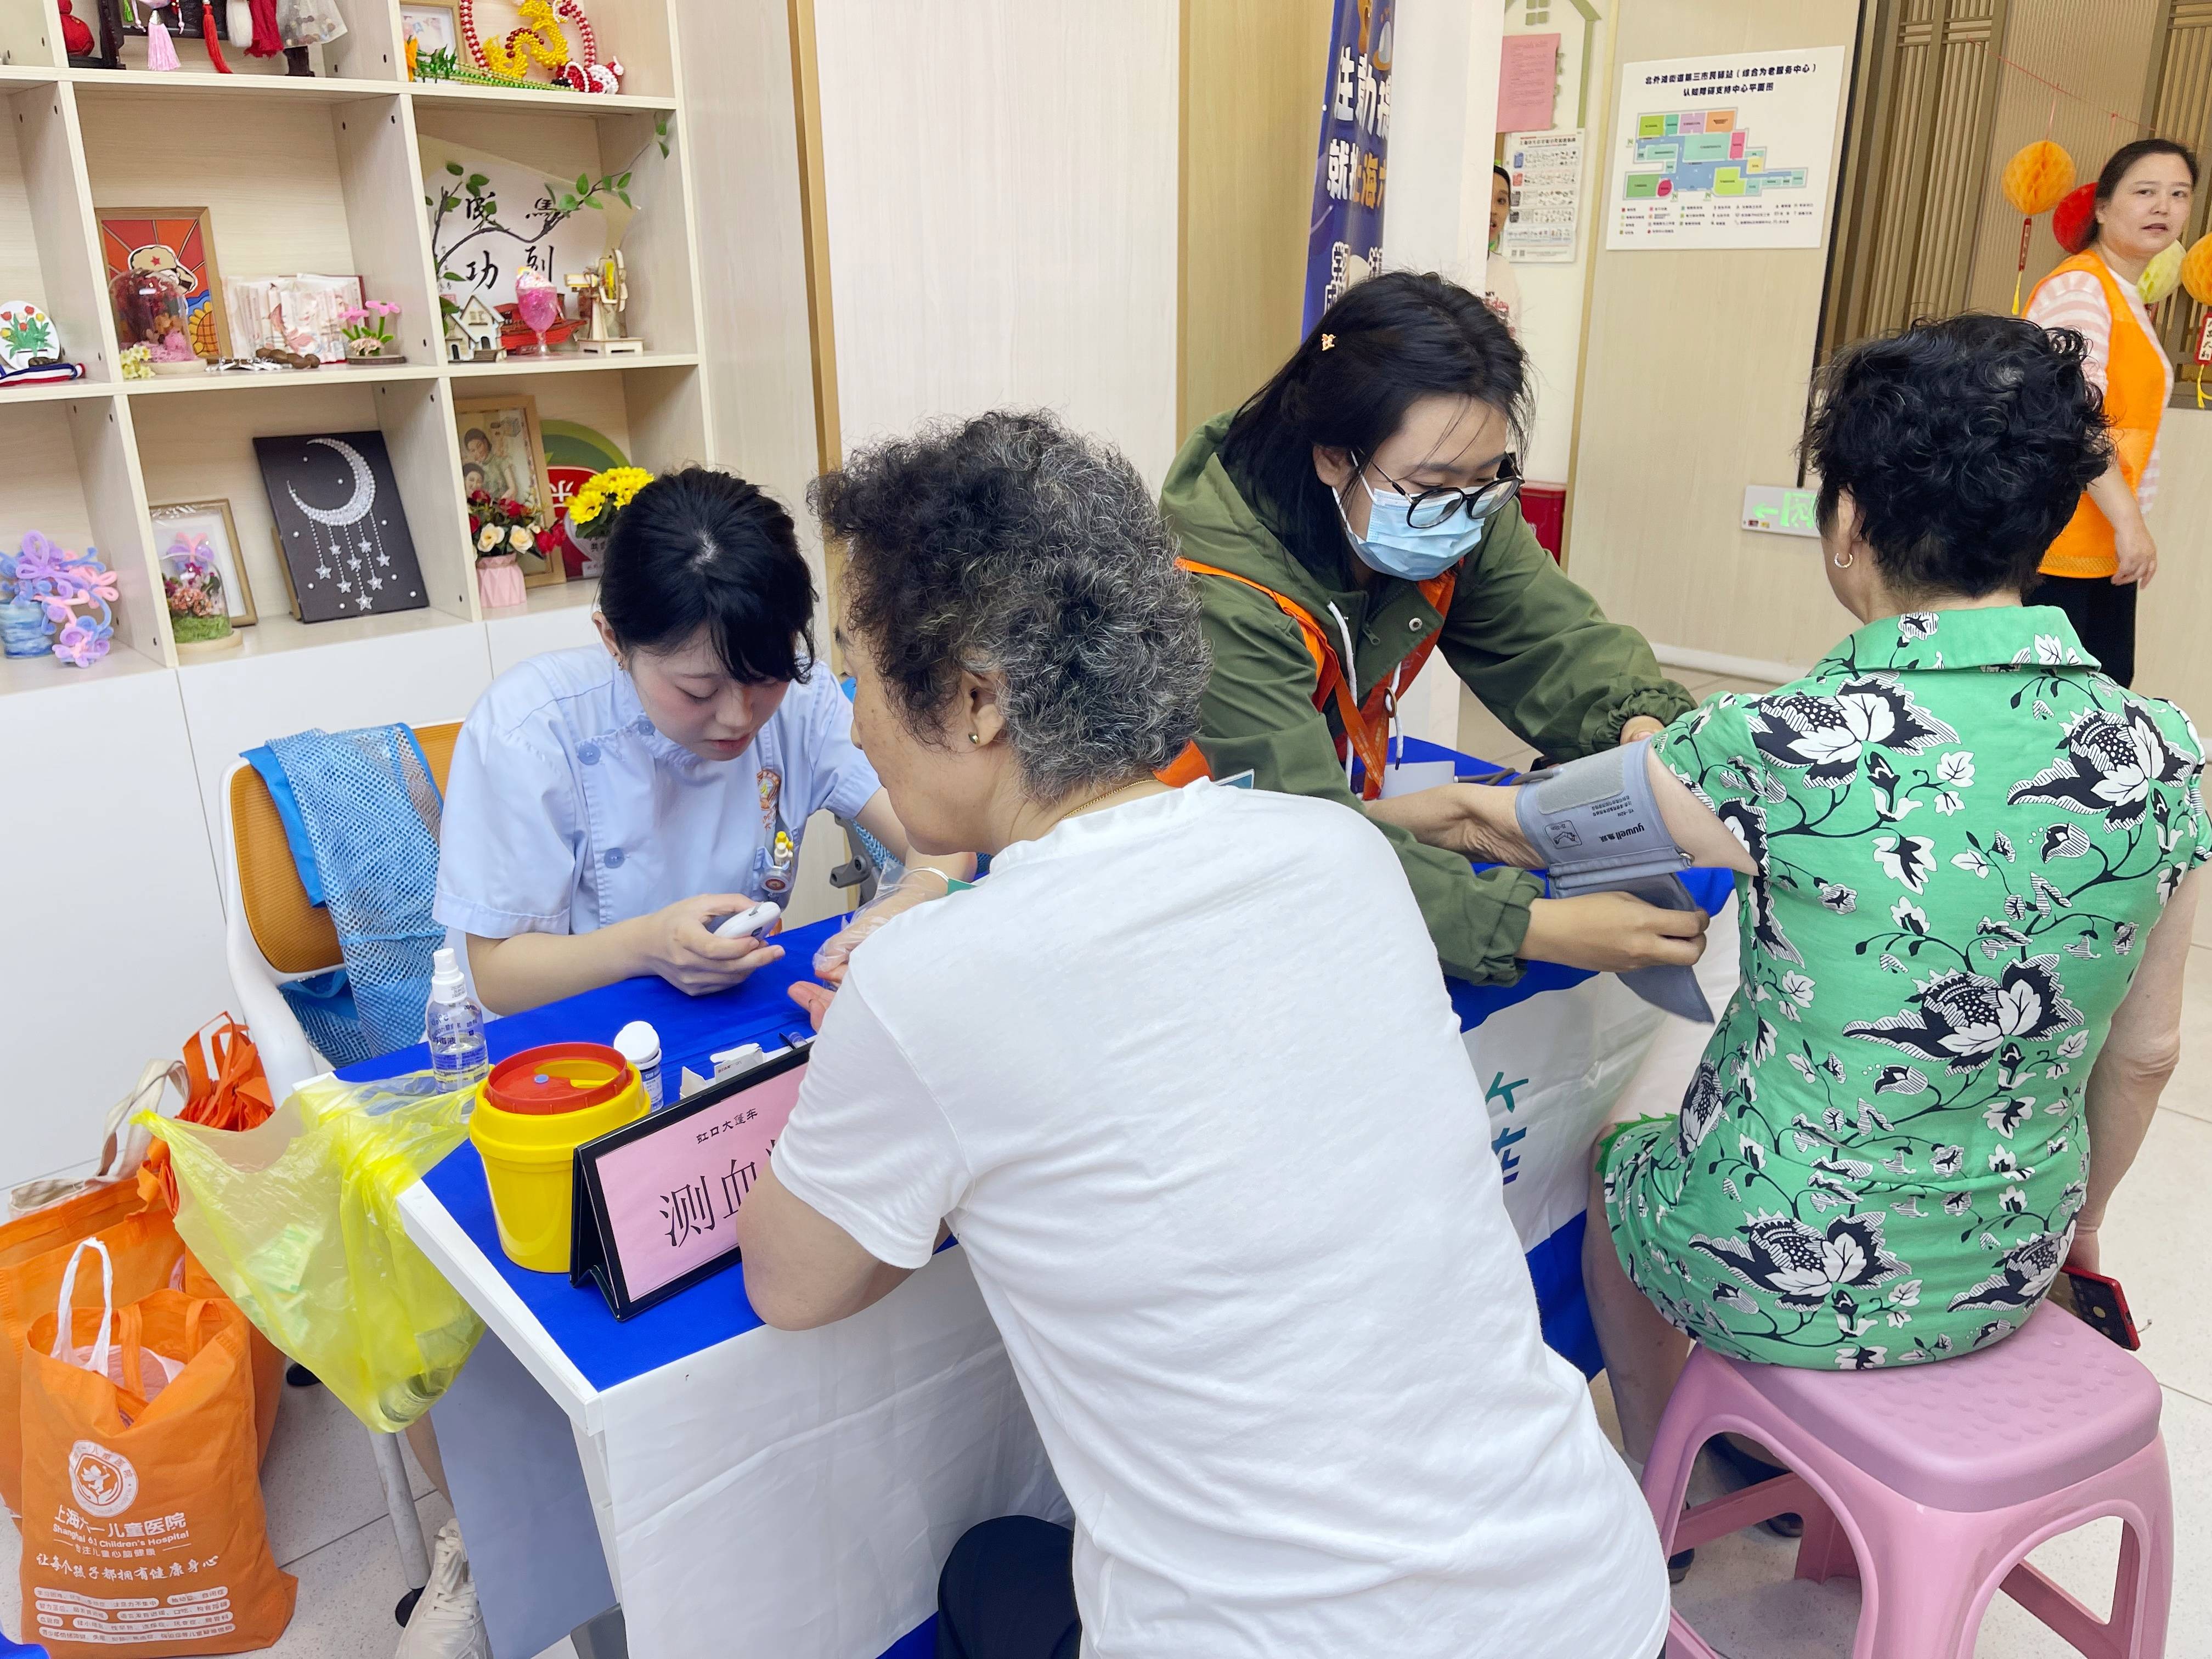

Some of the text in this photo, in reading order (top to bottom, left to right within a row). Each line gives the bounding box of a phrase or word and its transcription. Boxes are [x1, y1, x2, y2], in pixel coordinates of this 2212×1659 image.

[1616, 823, 1645, 840] yuwell
[696, 1108, 758, 1144] 虹口大篷车
[659, 1139, 776, 1248] 测血
[53, 1523, 86, 1543] Shanghai
[99, 1539, 145, 1548] Children's
[148, 1530, 190, 1545] Hospital
[54, 1504, 187, 1538] 上海六一儿童医院
[75, 1544, 156, 1559] 专注儿童心脑健康
[36, 1553, 218, 1582] 让每个孩子都拥有健康身心
